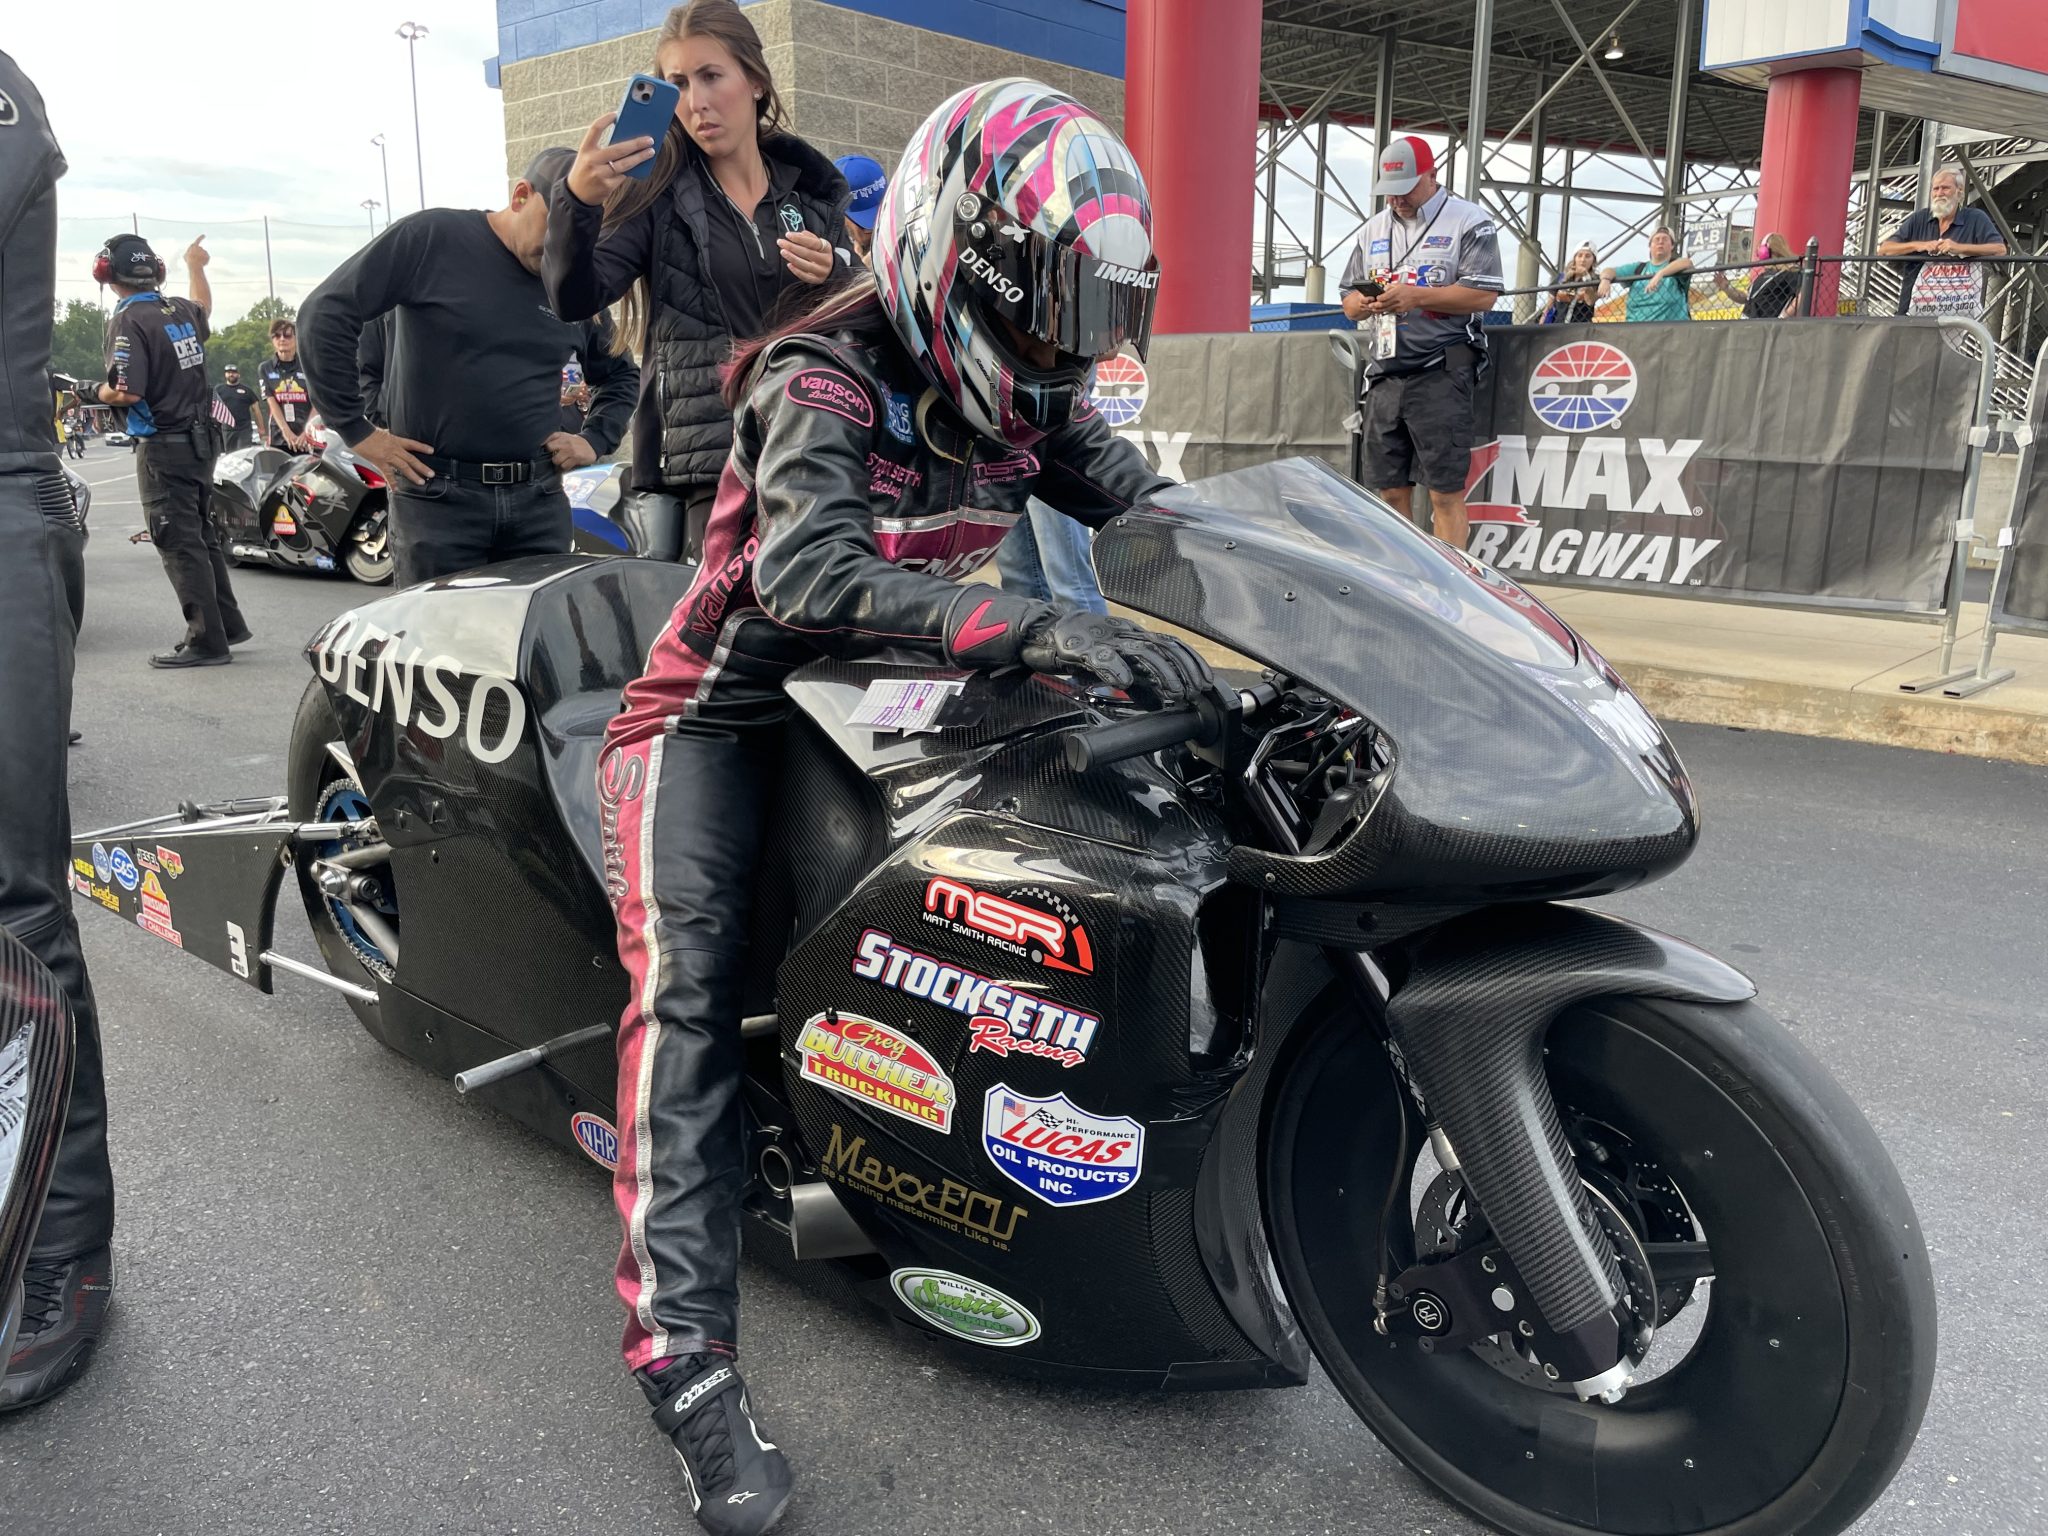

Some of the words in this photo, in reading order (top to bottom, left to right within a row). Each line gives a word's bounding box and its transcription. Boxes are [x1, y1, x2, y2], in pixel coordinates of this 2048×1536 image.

[1693, 229, 1720, 246] A-B
[959, 246, 1024, 303] DENSO
[1094, 262, 1159, 289] IMPACT
[808, 390, 851, 411] Leathers
[1468, 523, 1721, 584] RAGWAY
[319, 611, 526, 764] DENSO
[923, 912, 950, 928] MATT
[952, 923, 985, 942] SMITH
[987, 935, 1027, 957] RACING
[927, 877, 1064, 956] MSR
[227, 920, 249, 978] 3
[853, 928, 1099, 1056] STOCKSETH
[842, 1021, 907, 1061] Greg
[969, 1016, 1086, 1068] Racing
[803, 1025, 952, 1105] BUTCHER
[811, 1059, 938, 1122] TRUCKING
[582, 1122, 617, 1162] NHR
[1001, 1120, 1132, 1163] LUCAS
[1066, 1117, 1079, 1125] HI-
[1066, 1125, 1136, 1139] PERFORMANCE
[822, 1123, 1028, 1241] MaxxECU
[992, 1144, 1021, 1164] OIL
[1027, 1156, 1130, 1183] PRODUCTS
[821, 1164, 836, 1178] Be
[838, 1175, 846, 1184] a
[848, 1178, 884, 1202] tuning
[886, 1195, 961, 1233] mastermind.
[965, 1226, 990, 1244] Like
[992, 1239, 1011, 1251] us.
[1039, 1177, 1077, 1195] INC.
[913, 1279, 1014, 1319] Smith
[939, 1280, 977, 1294] WILLIAM
